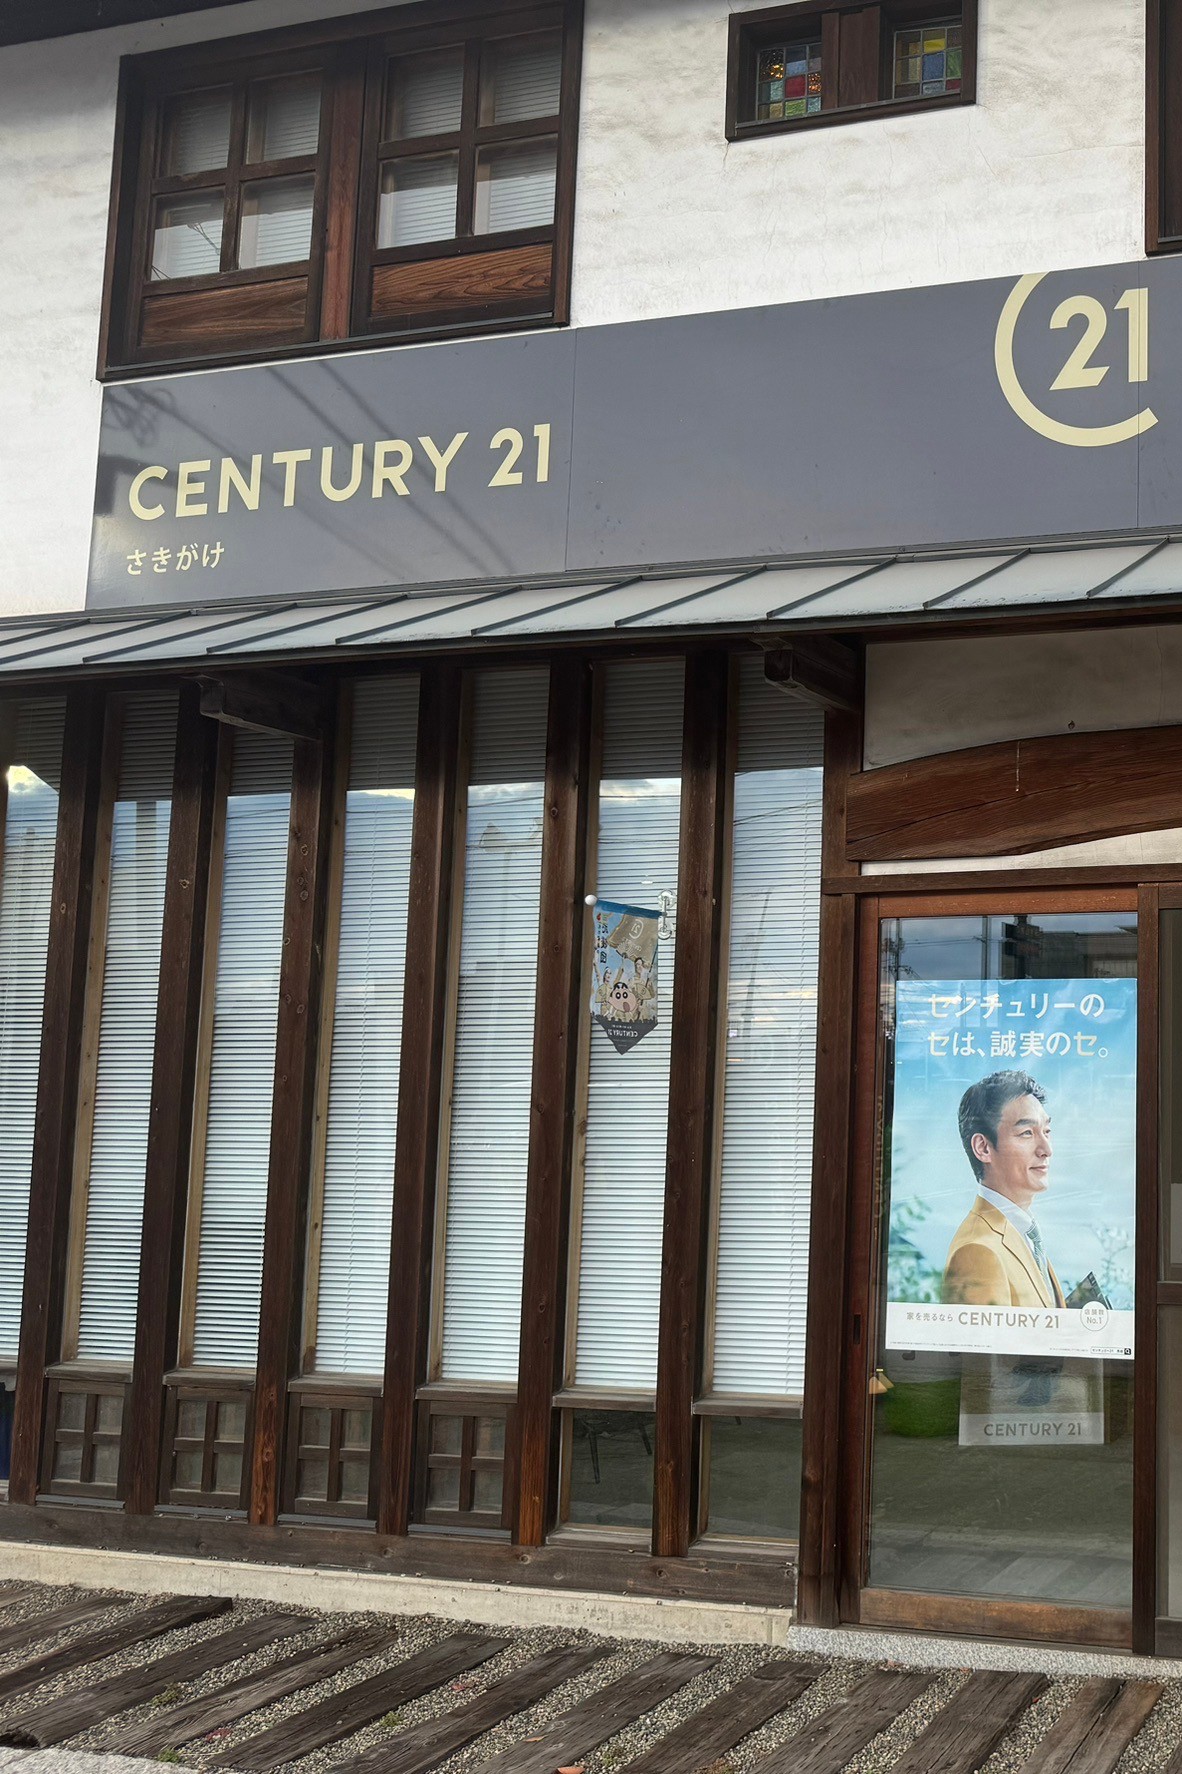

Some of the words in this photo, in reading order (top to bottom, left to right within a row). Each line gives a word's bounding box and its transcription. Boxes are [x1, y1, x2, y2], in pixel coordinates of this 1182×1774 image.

[127, 432, 470, 522] CENTURY
[488, 423, 551, 488] 21
[126, 541, 226, 577] さきがけ
[927, 992, 1105, 1020] センチュリーの
[927, 1030, 1109, 1059] セは、誠実のセ。
[958, 1311, 1040, 1329] CENTURY
[1045, 1315, 1060, 1329] 21
[984, 1423, 1064, 1437] CENTURY
[1067, 1422, 1082, 1436] 21
